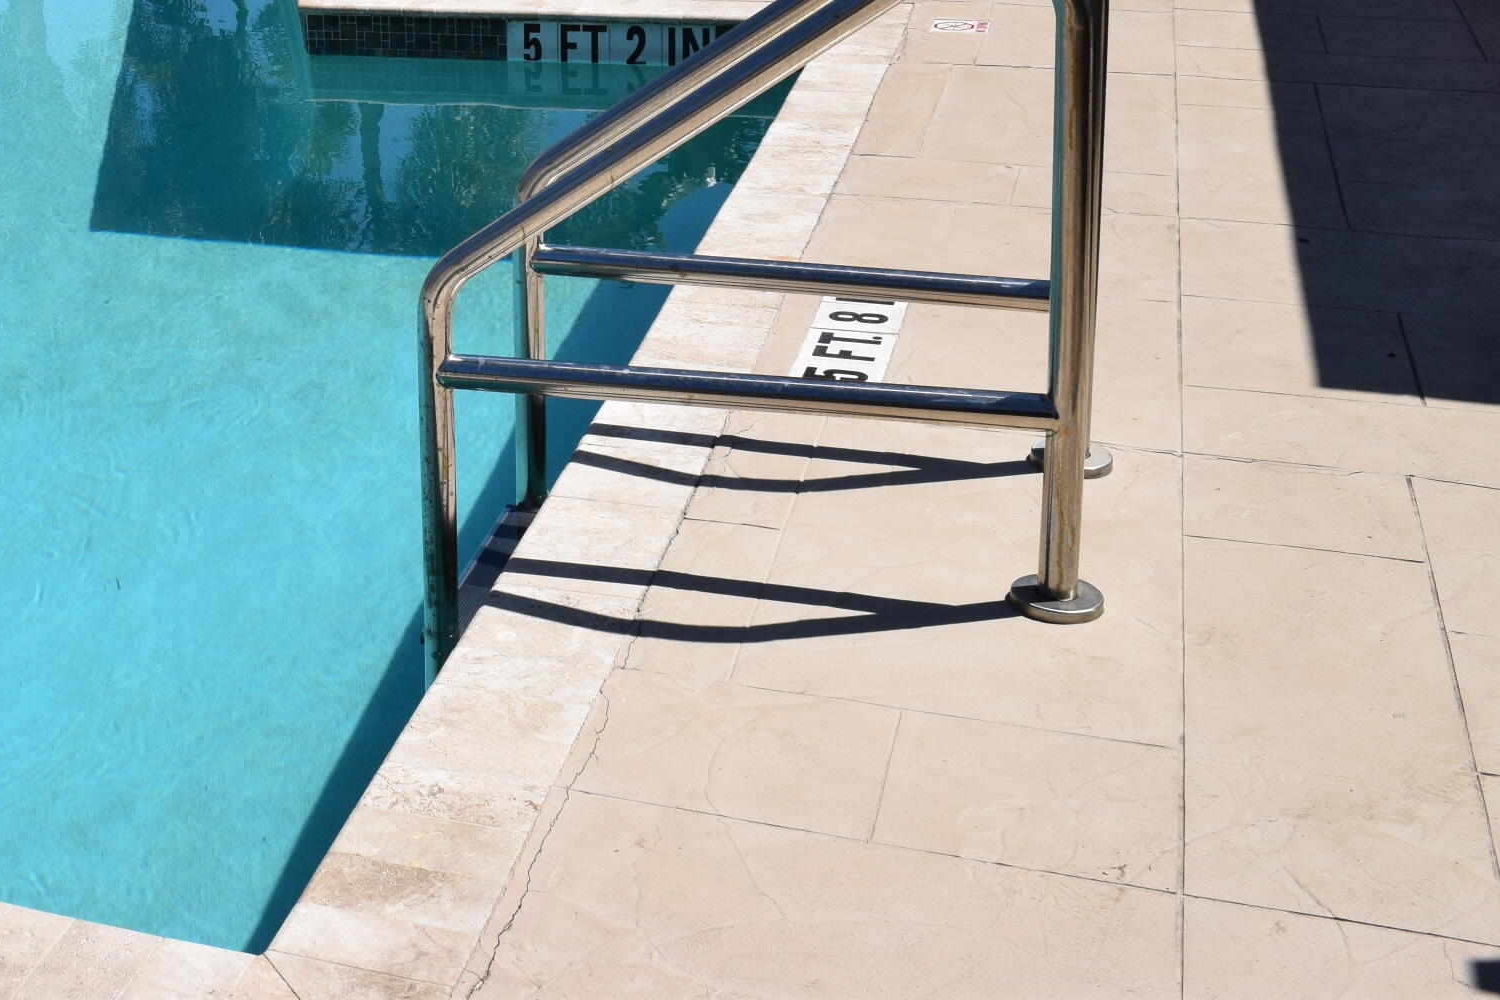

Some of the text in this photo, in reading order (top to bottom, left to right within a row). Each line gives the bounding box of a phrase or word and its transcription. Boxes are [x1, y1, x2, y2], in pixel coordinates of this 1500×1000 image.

[523, 23, 710, 66] 5 FT 2 IN
[829, 310, 889, 324] 8
[803, 366, 869, 382] 5
